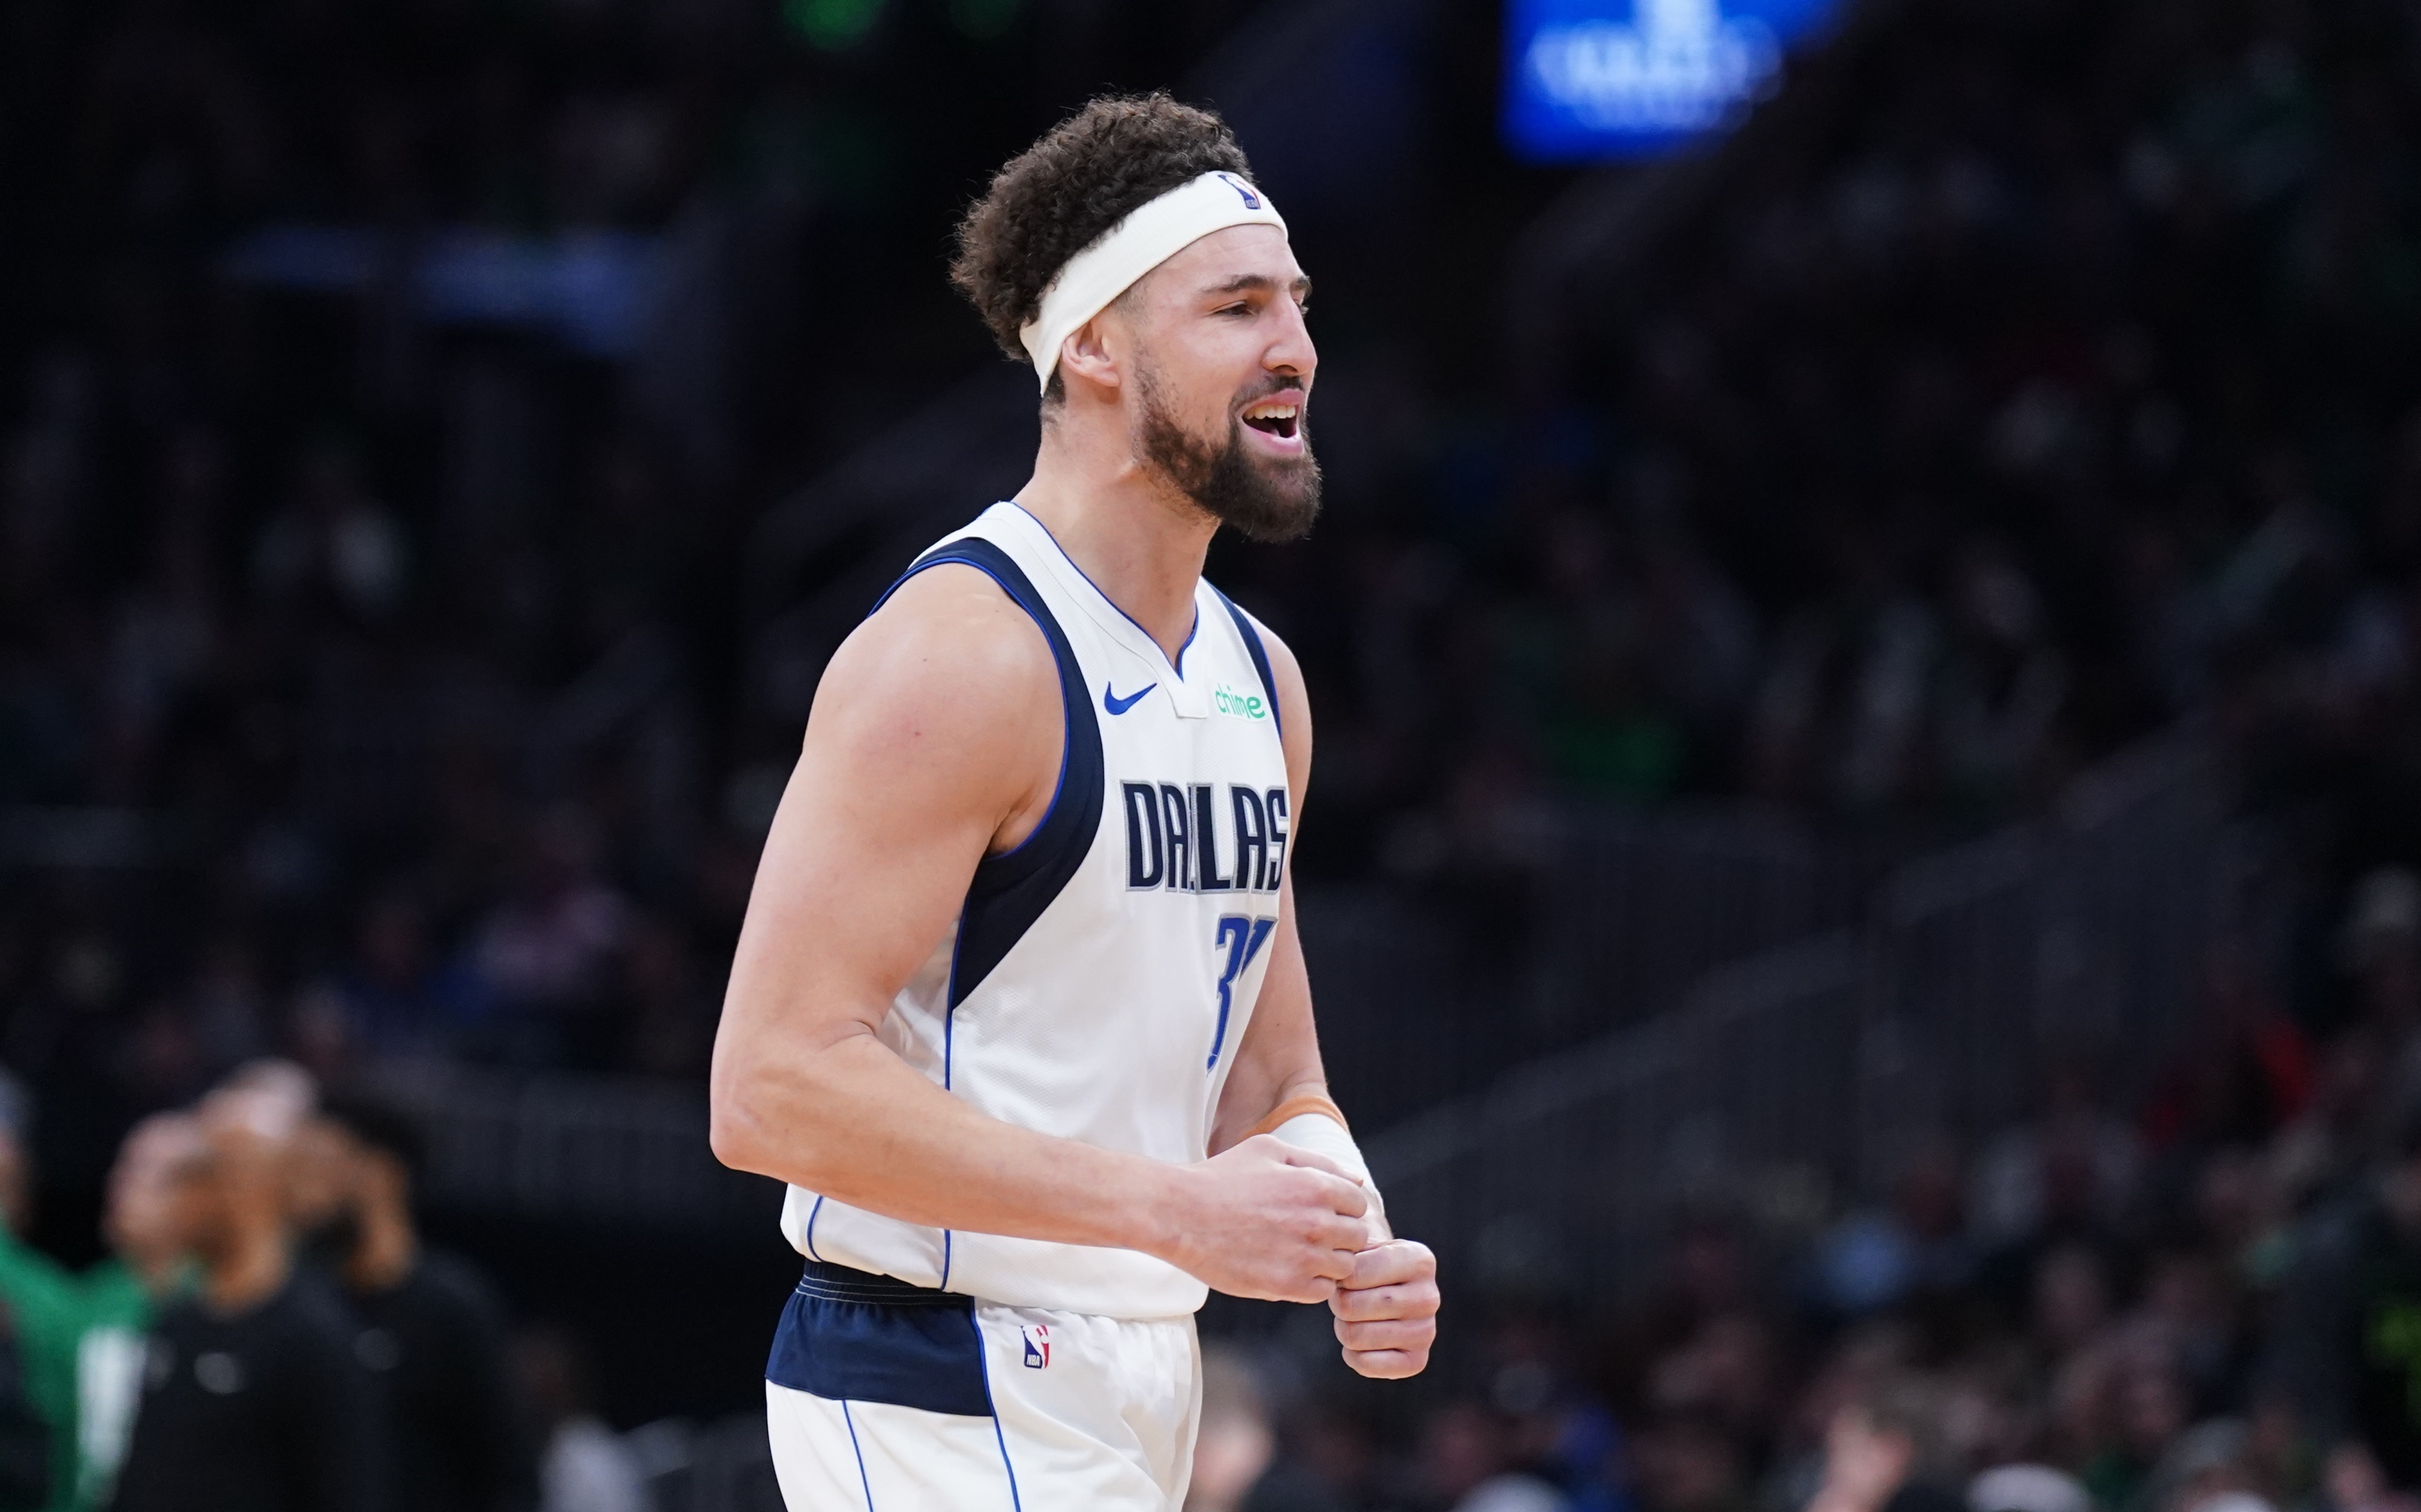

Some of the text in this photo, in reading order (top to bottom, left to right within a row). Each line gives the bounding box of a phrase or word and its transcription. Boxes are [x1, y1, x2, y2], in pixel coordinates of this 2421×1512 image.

[1216, 683, 1265, 719] chime
[1120, 779, 1289, 895] DALAS
[1027, 1354, 1040, 1366] NBA
